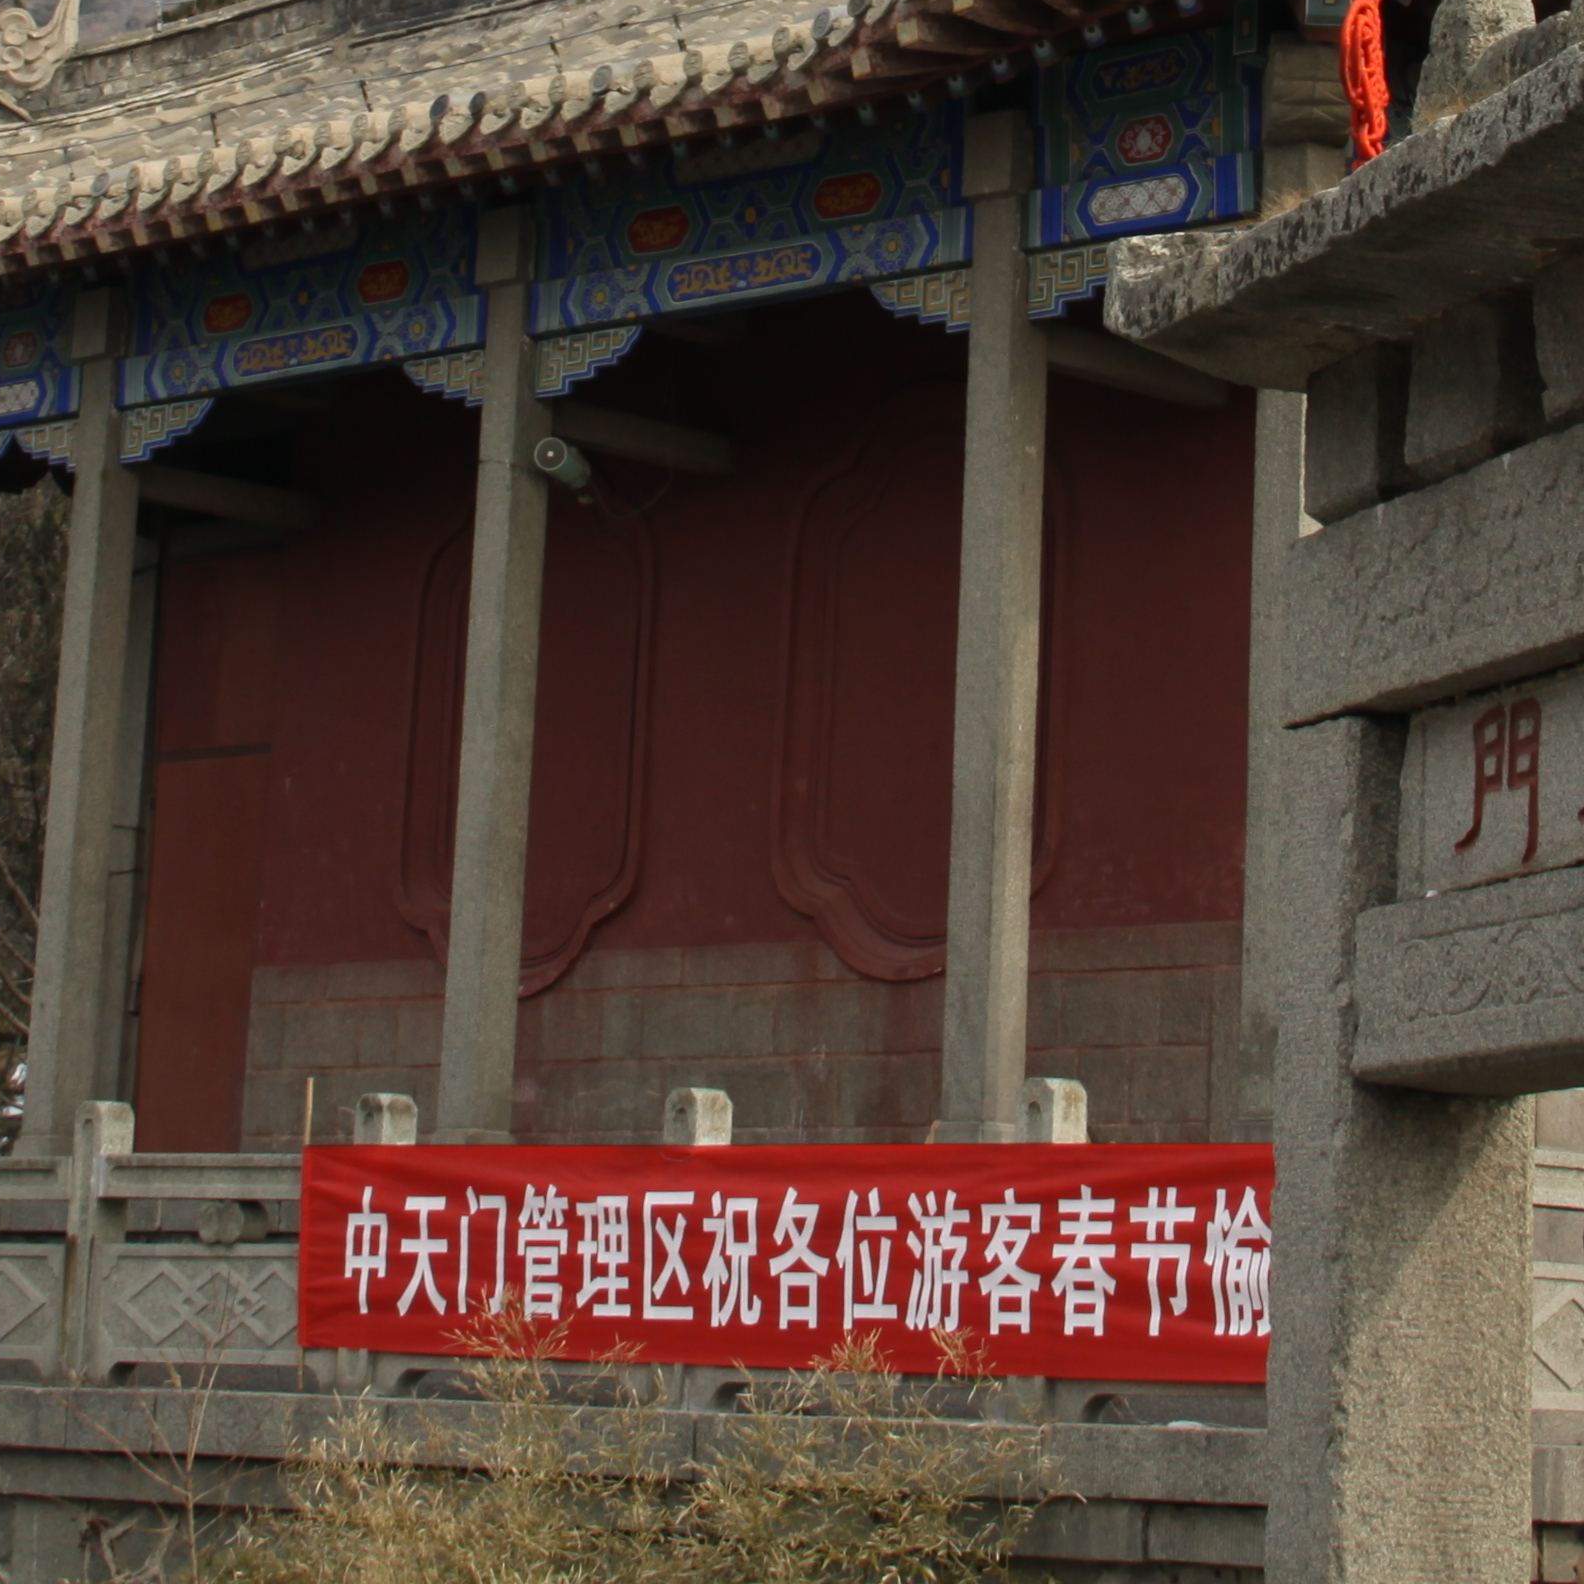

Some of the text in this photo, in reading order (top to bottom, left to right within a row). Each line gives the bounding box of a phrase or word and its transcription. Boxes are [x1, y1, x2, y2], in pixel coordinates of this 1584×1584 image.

[344, 1183, 1272, 1337] 中天门管理区祝各位游客春节愉
